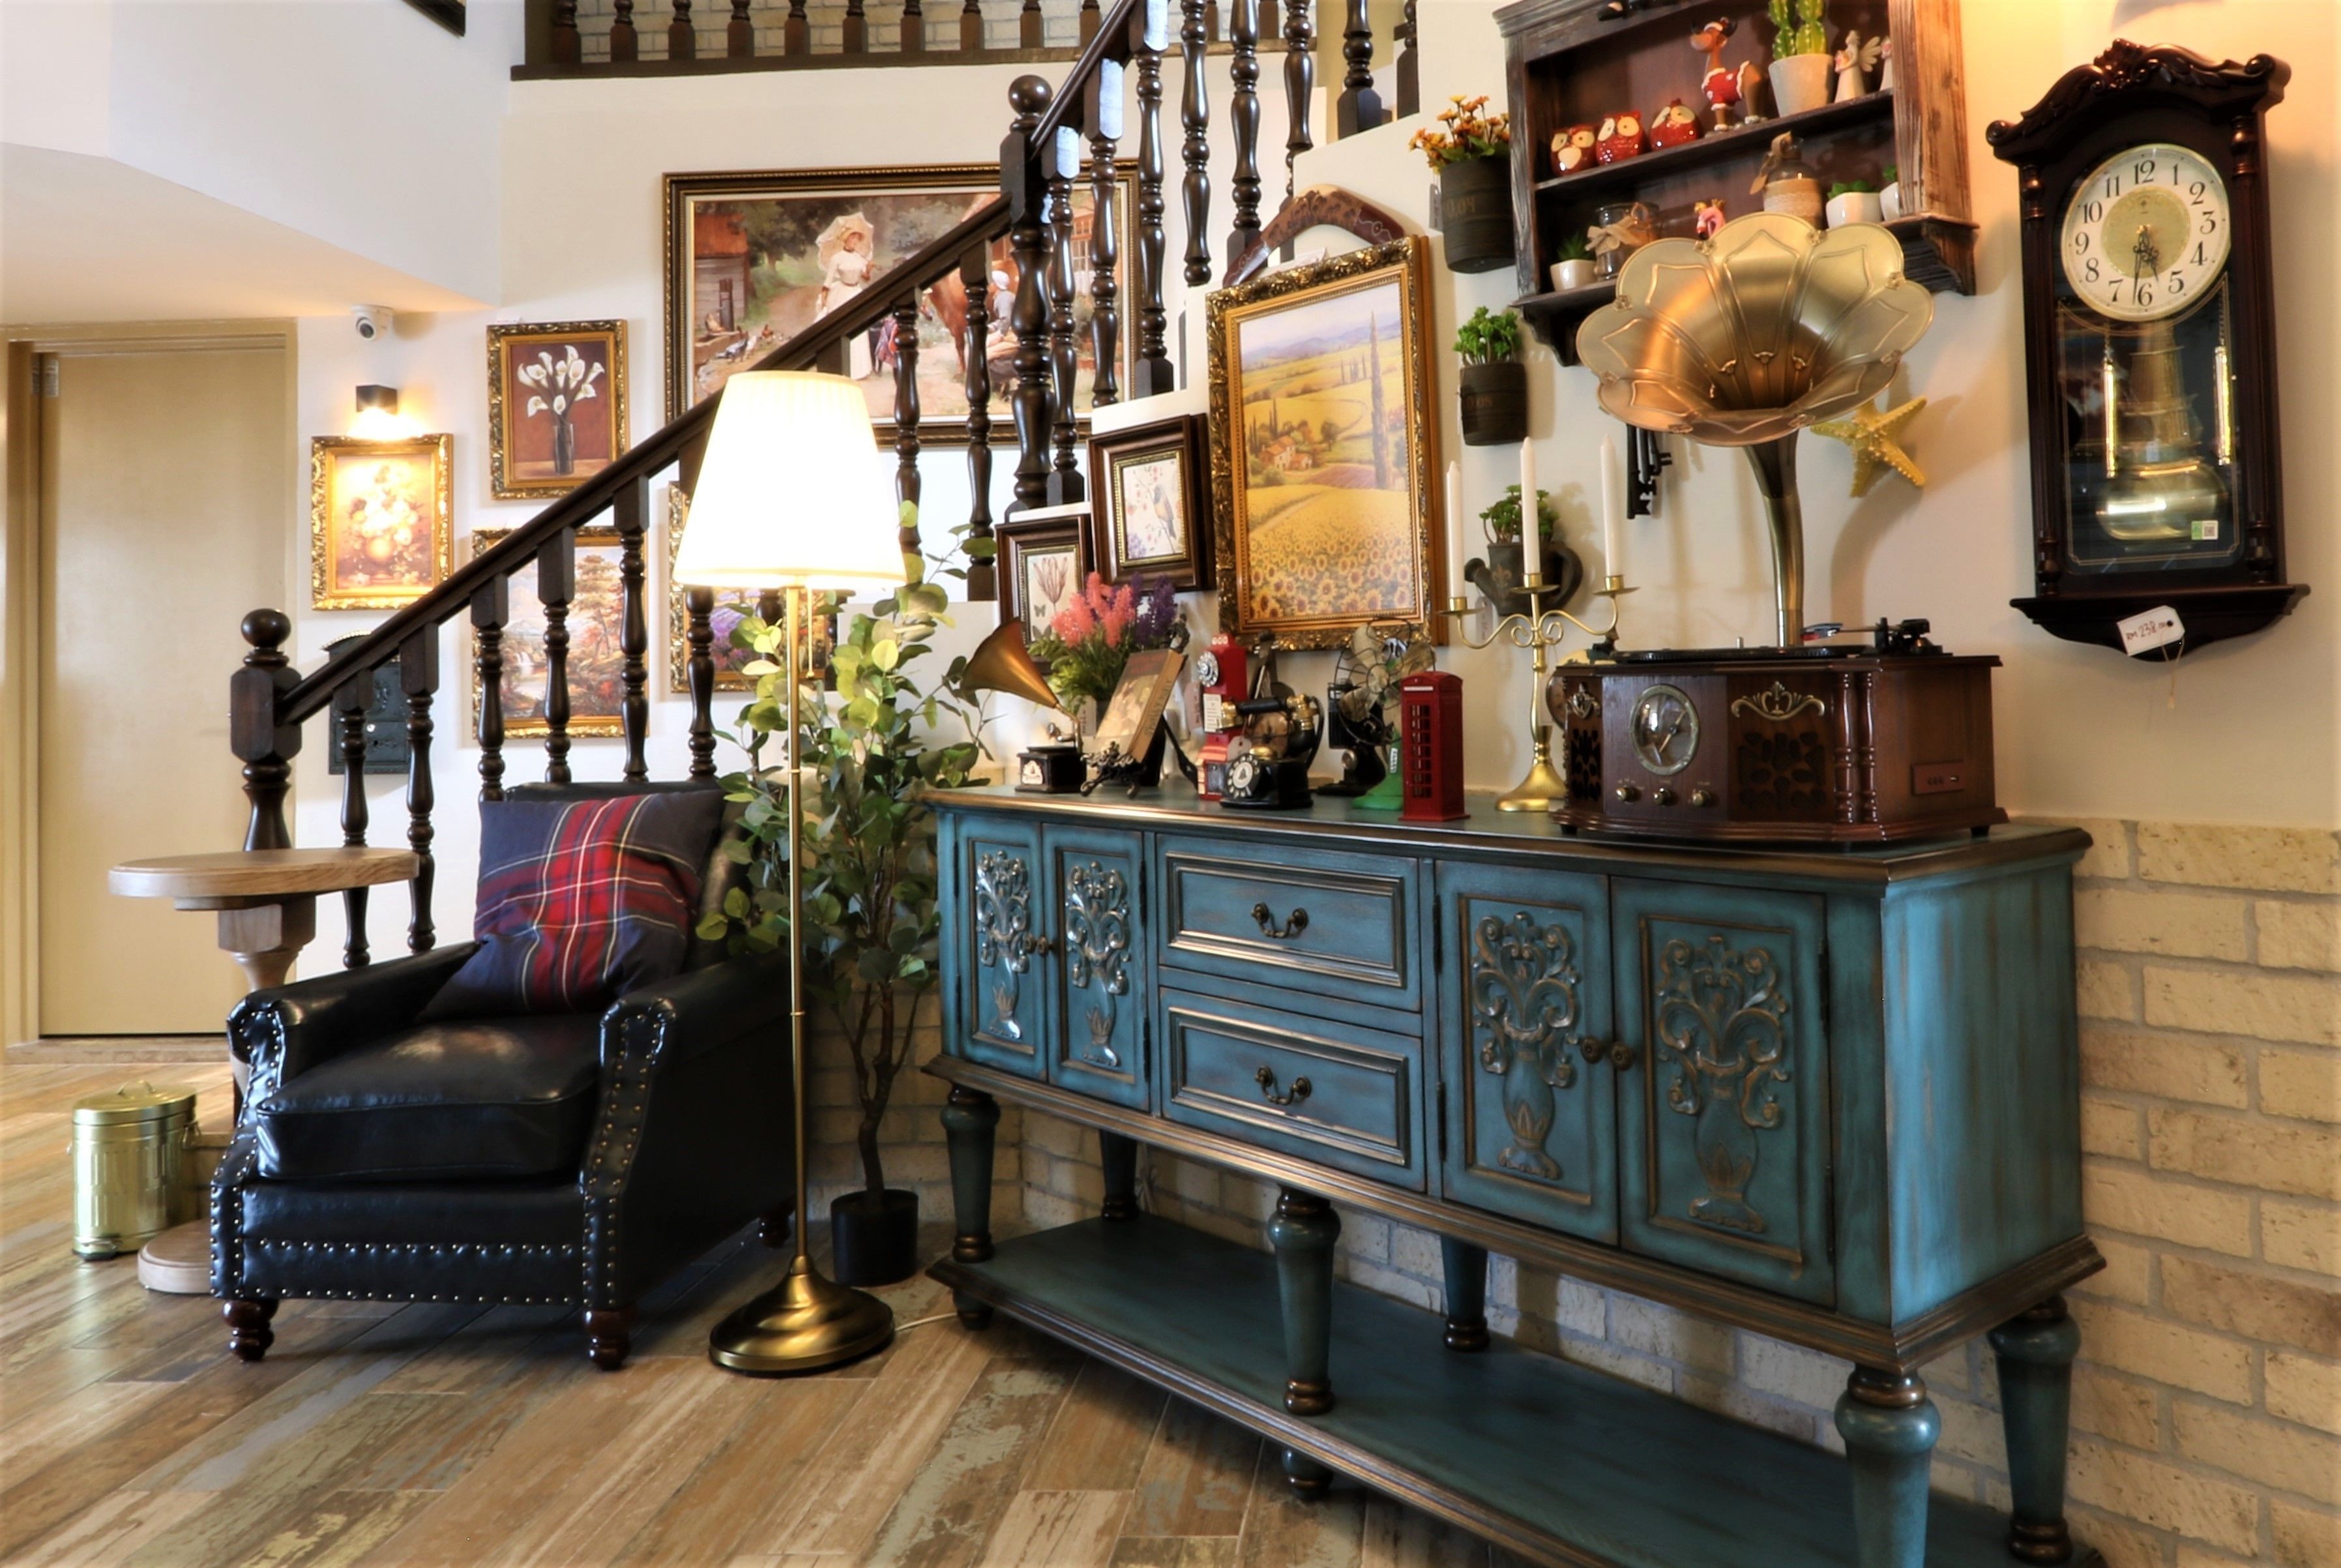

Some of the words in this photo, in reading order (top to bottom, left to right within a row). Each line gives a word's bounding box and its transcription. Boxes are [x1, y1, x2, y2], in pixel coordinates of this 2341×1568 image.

[2134, 160, 2156, 185] 12
[2172, 164, 2179, 186] 1
[2106, 175, 2120, 198] 11
[2189, 181, 2205, 205] 2
[2083, 201, 2102, 224] 10
[2200, 211, 2216, 235] 3
[2075, 232, 2089, 256] 9
[2190, 241, 2207, 266] 4
[2085, 258, 2099, 283] 8
[2168, 270, 2184, 294] 5
[2108, 279, 2123, 303] 7
[2138, 283, 2153, 306] 6
